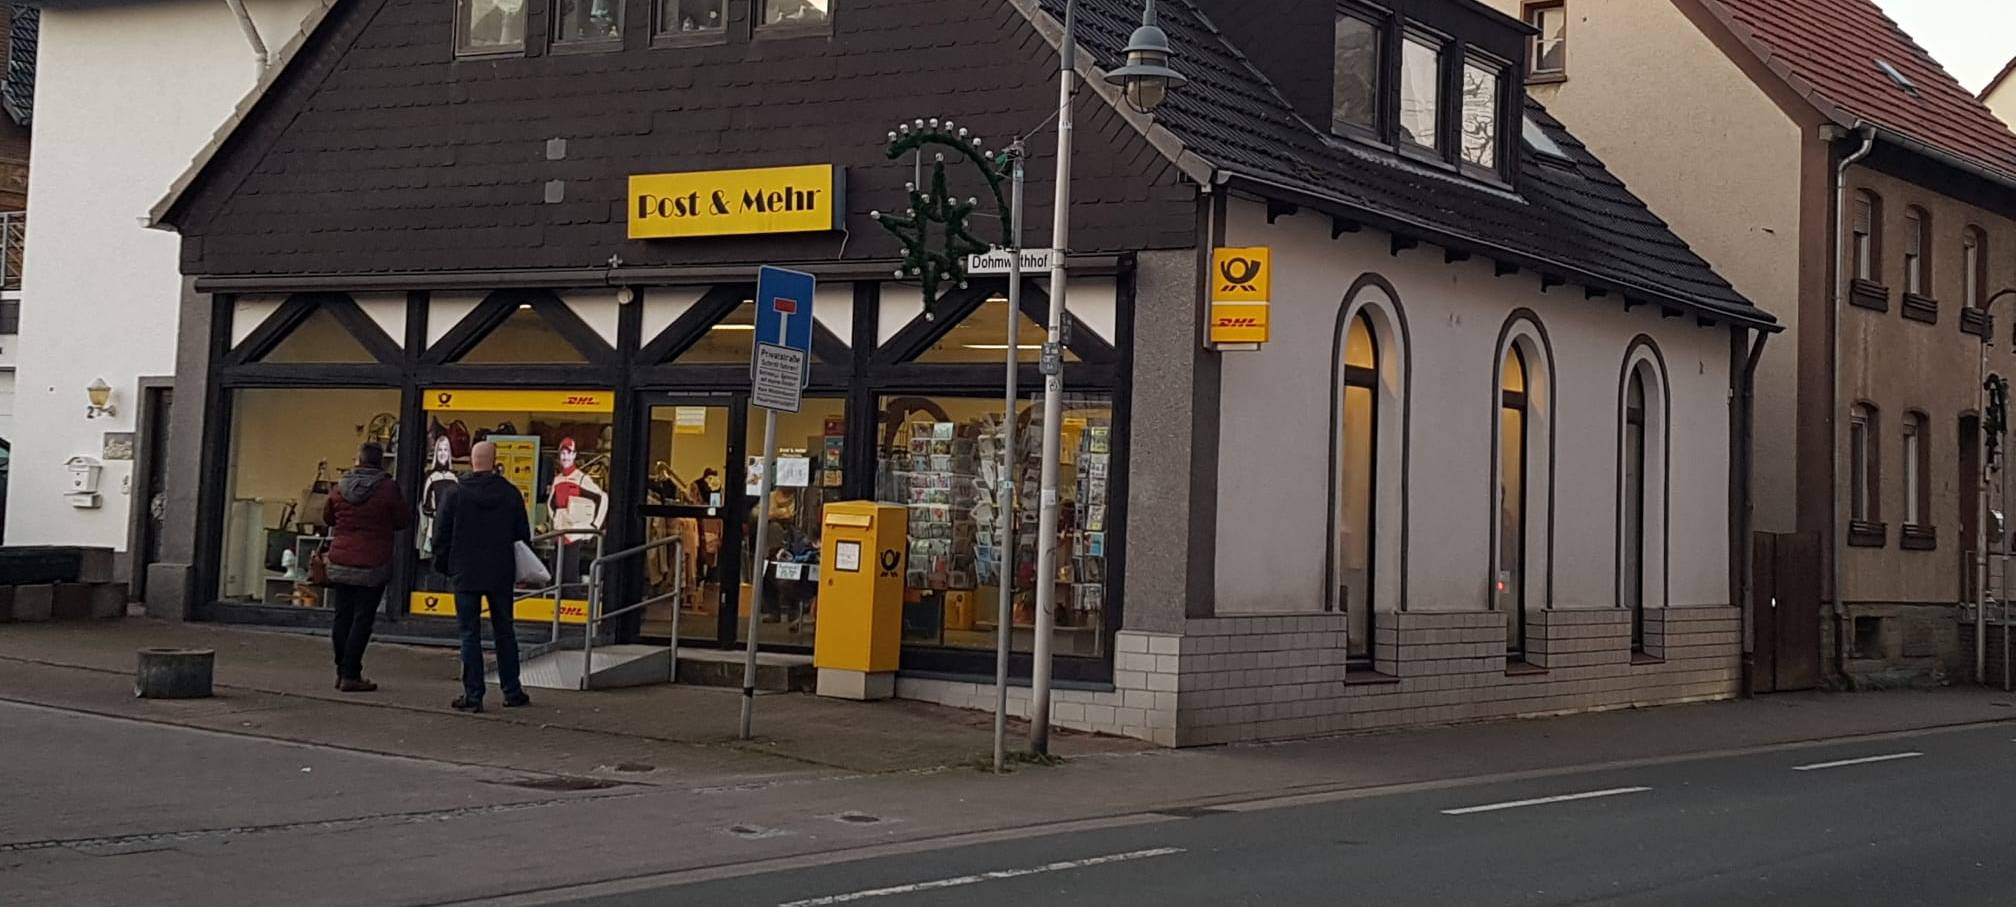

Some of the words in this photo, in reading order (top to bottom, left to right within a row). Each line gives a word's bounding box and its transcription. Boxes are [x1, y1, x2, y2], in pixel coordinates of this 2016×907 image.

[638, 191, 700, 219] Post
[709, 189, 730, 216] &
[739, 186, 822, 214] Mehr
[972, 253, 1048, 269] Dohmwthhof
[1218, 318, 1258, 327] DHL
[566, 396, 595, 405] DHL
[86, 405, 96, 419] 2
[559, 605, 585, 616] DHL
